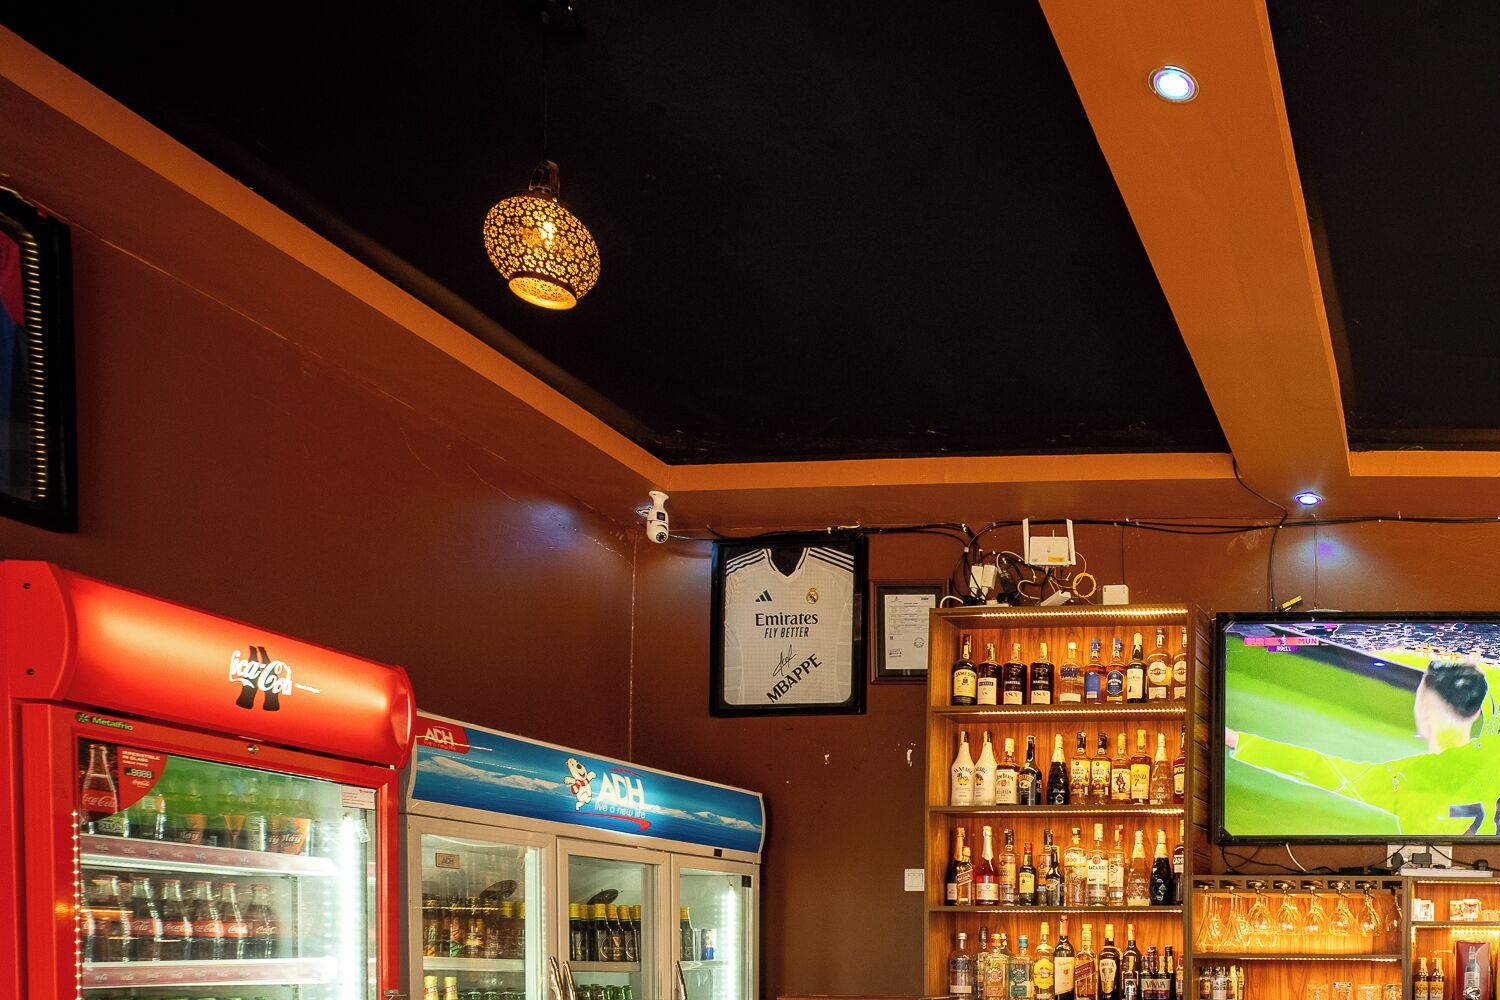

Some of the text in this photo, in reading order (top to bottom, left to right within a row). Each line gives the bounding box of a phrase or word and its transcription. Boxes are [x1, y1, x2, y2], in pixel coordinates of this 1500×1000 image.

[755, 611, 819, 627] Emirates
[764, 626, 810, 639] FLY BETTER
[766, 653, 823, 704] MBAPPE
[954, 670, 977, 679] JAMESON
[92, 717, 134, 731] Metalfrio
[425, 727, 455, 746] ADH
[595, 771, 646, 809] ADH
[594, 801, 608, 812] live
[616, 806, 633, 817] new
[634, 808, 646, 819] life
